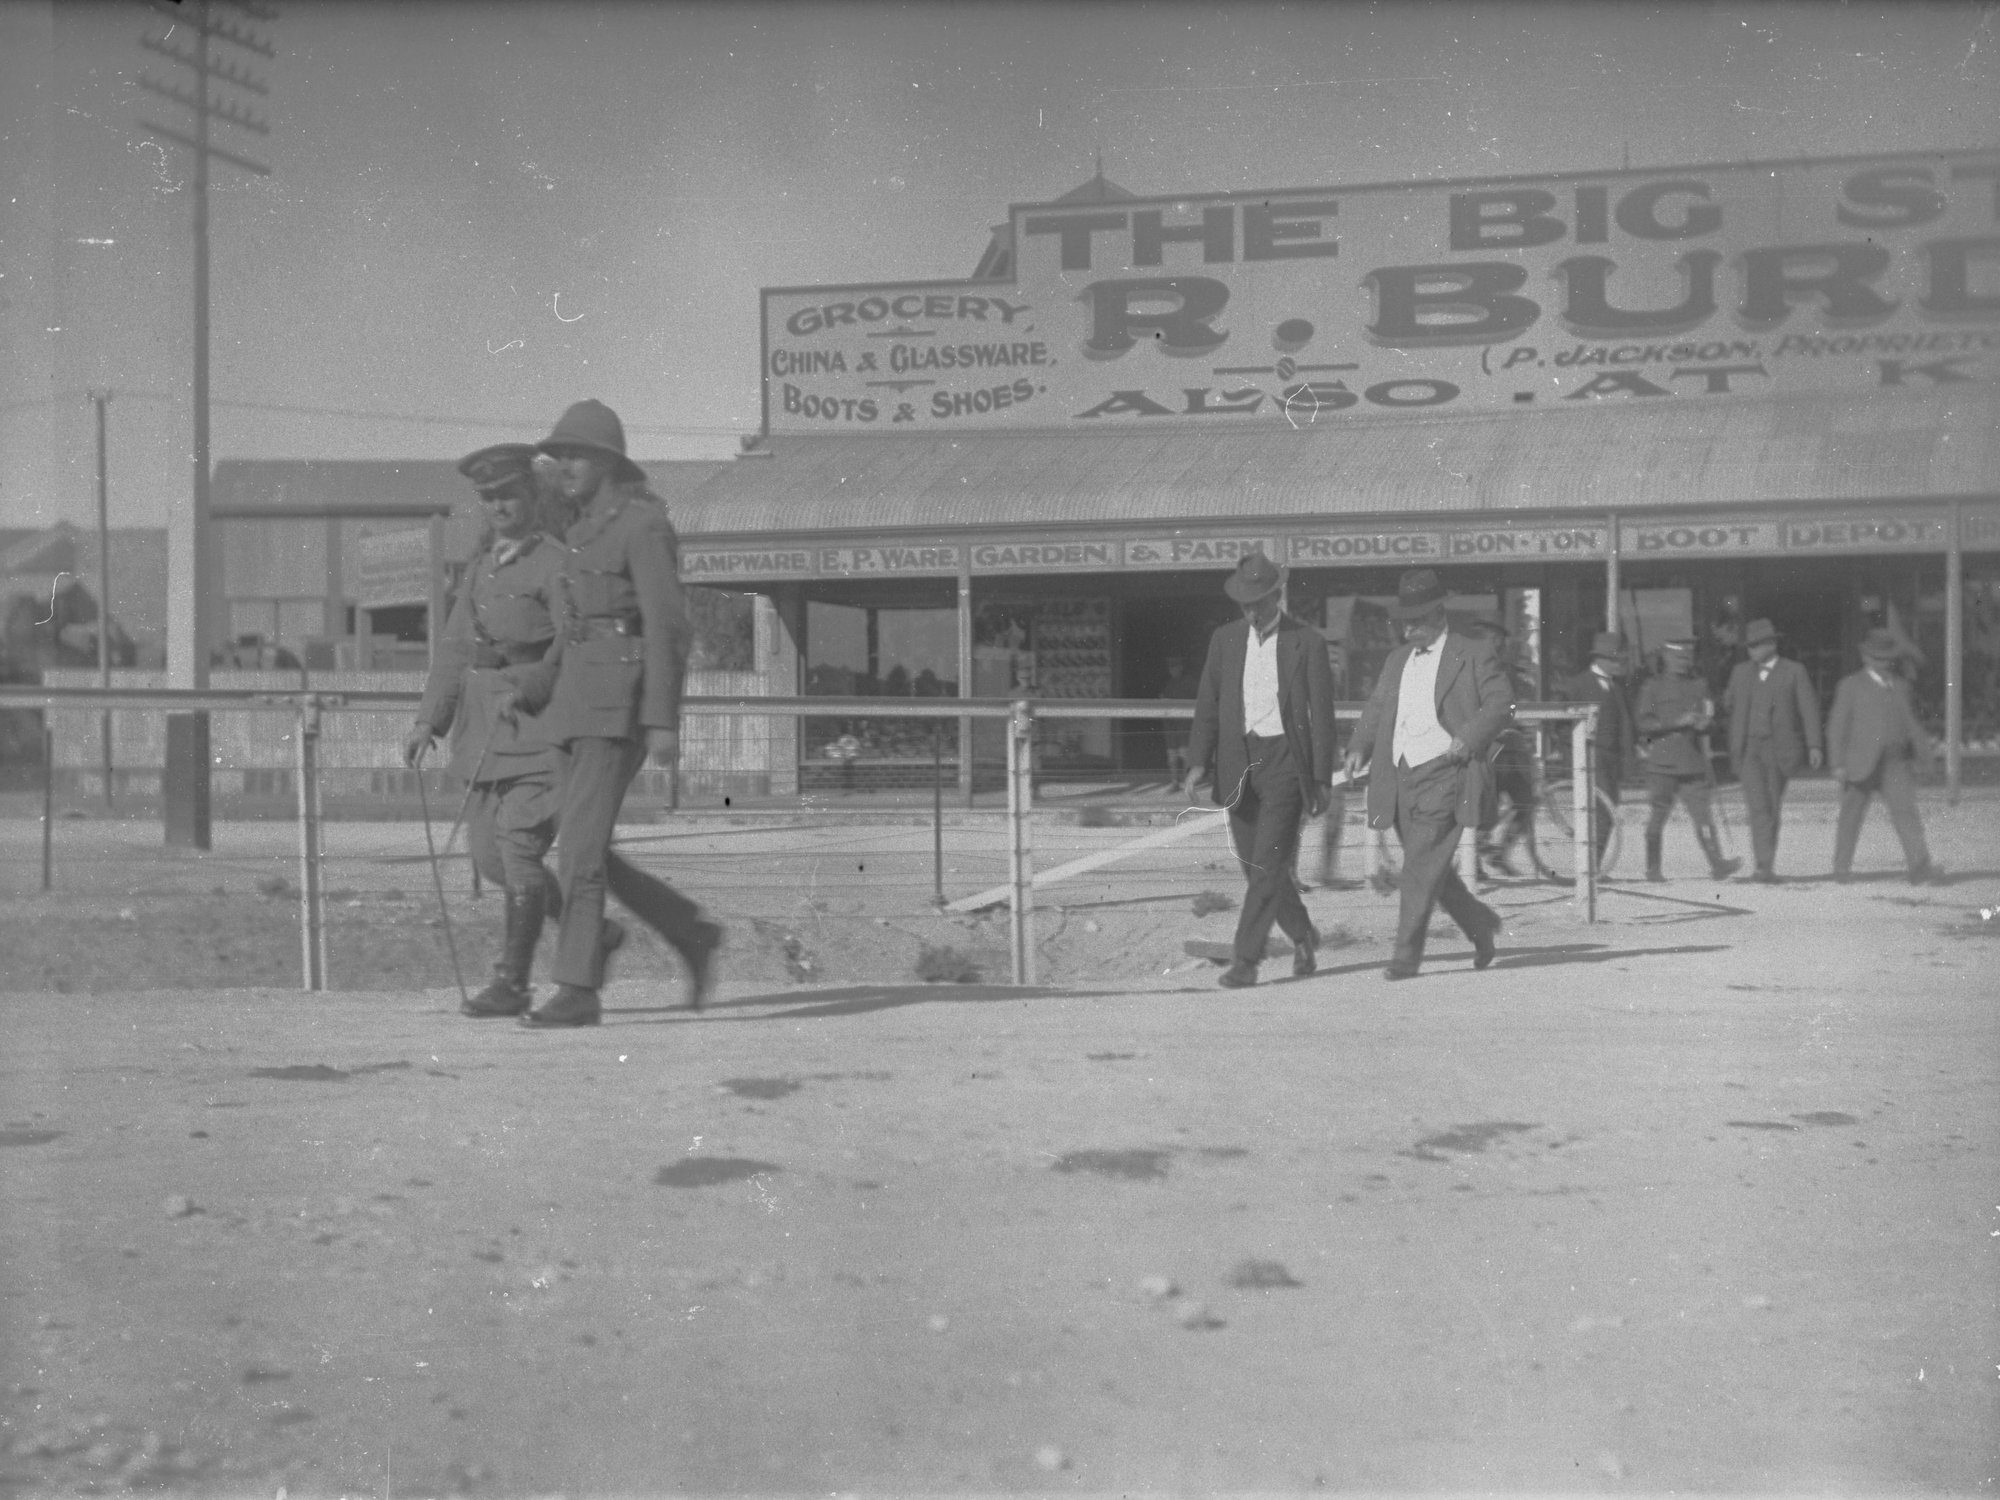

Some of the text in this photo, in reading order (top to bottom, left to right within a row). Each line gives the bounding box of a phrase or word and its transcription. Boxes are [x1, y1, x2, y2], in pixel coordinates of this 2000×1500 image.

[1025, 201, 1338, 270] THE
[1450, 180, 1723, 252] BIG
[786, 295, 1034, 336] GROCERY,
[1078, 276, 1315, 361] R.
[771, 342, 1058, 377] CHINA & GLASSWARE,
[784, 377, 1047, 422] BOOTS & SHOES.
[1073, 378, 1461, 419] ALSO
[1560, 364, 1769, 399] AT
[1130, 545, 1160, 561] &
[1171, 540, 1264, 562] FARM
[1638, 527, 1759, 550] BOOT
